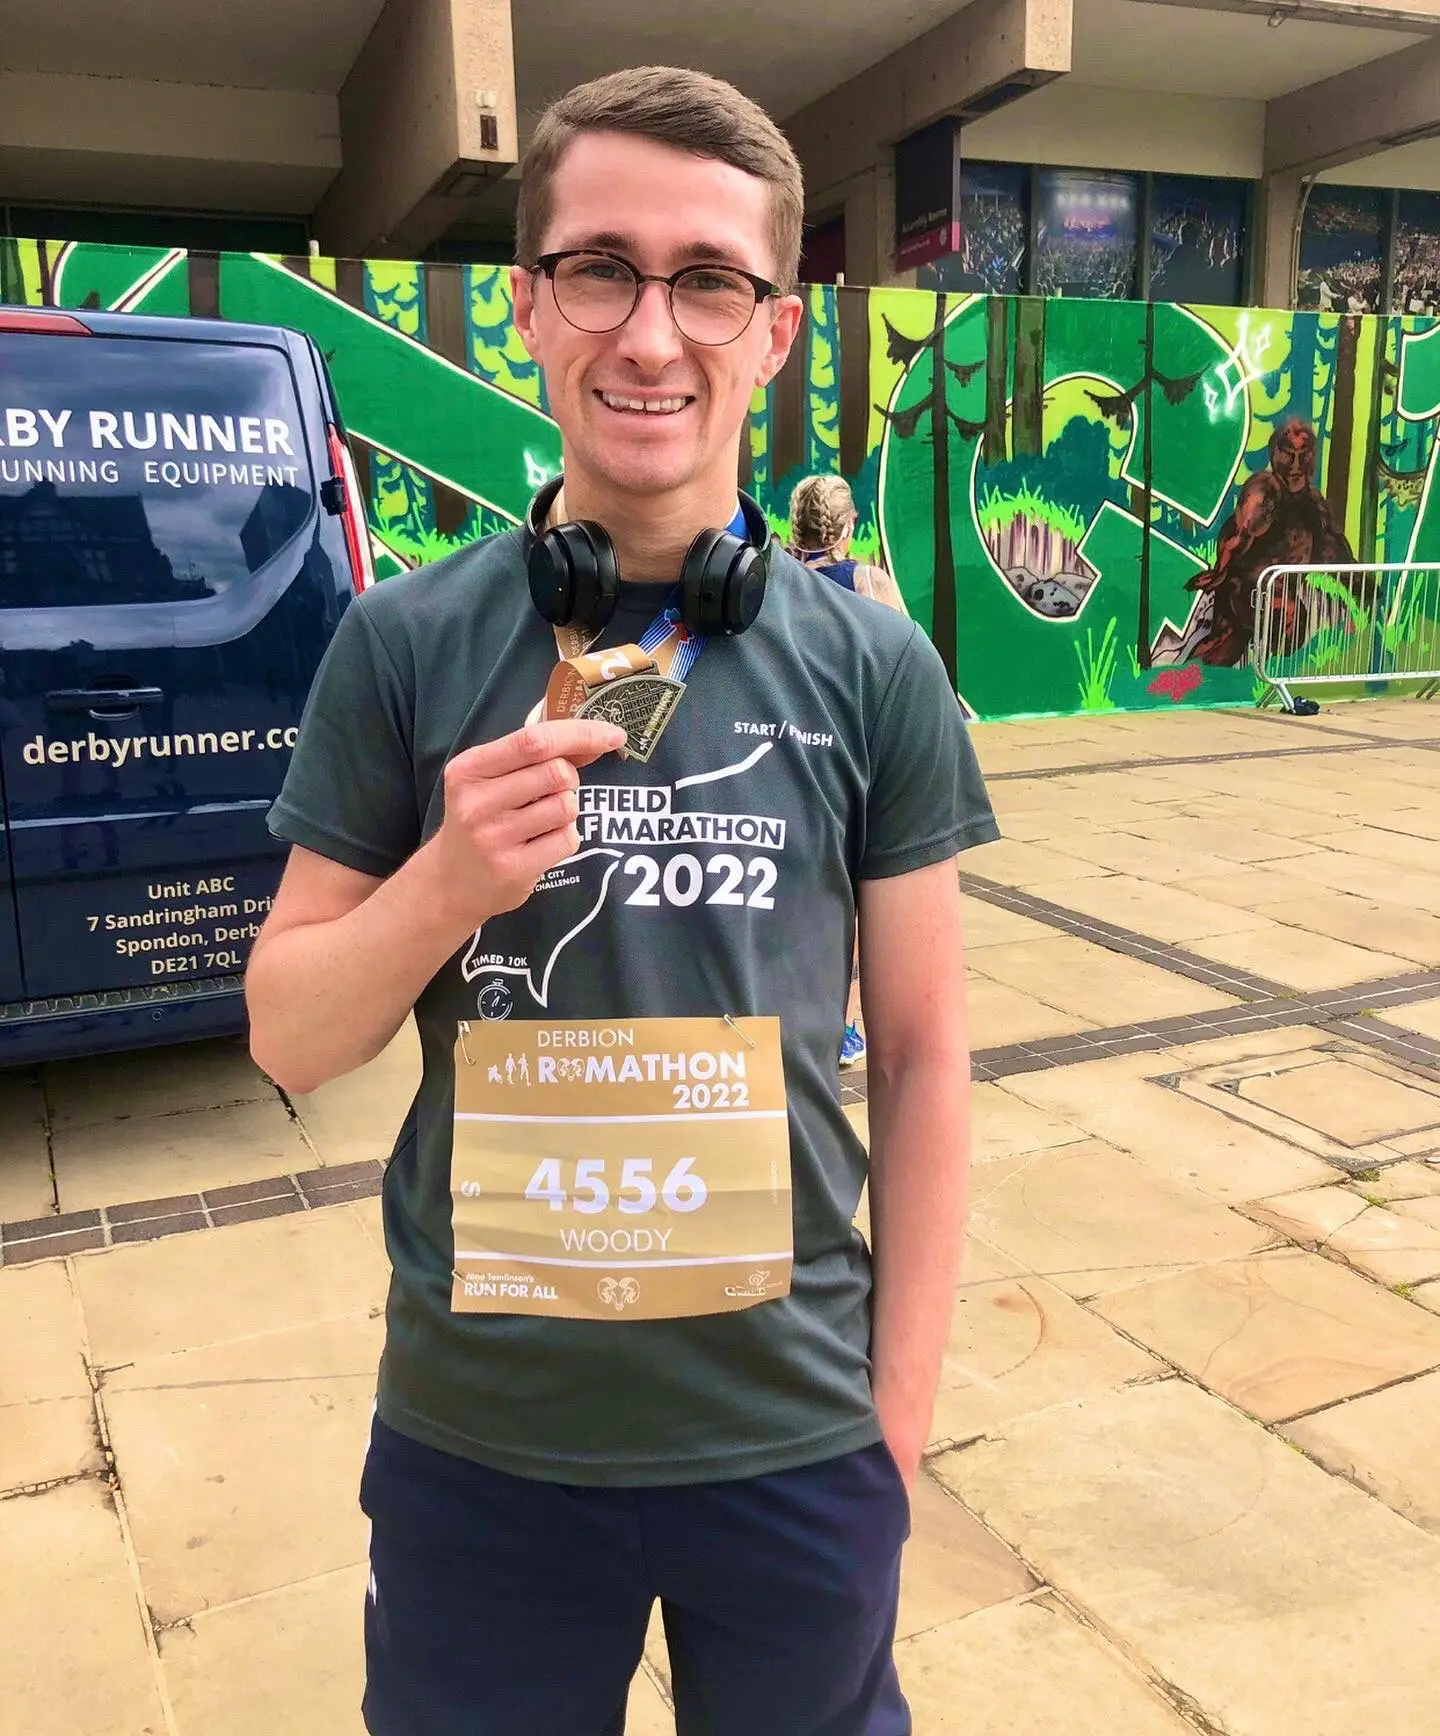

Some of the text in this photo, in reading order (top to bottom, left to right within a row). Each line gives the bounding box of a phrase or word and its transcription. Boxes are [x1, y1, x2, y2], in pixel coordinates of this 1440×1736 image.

[0, 408, 295, 456] BY RUNNER
[144, 461, 298, 489] EQUIPMENT
[734, 721, 777, 737] START
[606, 816, 783, 846] MARATHON
[547, 869, 565, 880] CITY
[623, 853, 778, 911] 2022
[147, 876, 235, 900] Unit ABC
[87, 916, 99, 932] 7
[105, 903, 238, 930] Sandringham
[116, 922, 264, 957] Spondon, Derb
[151, 950, 241, 975] DE21 7QL
[471, 954, 528, 968] TIMED 10K
[537, 1028, 634, 1048] DERBION
[673, 1083, 750, 1109] 2022
[525, 1157, 707, 1214] 4556
[559, 1228, 674, 1253] WOODY
[464, 1283, 559, 1300] RUN FOR ALL
